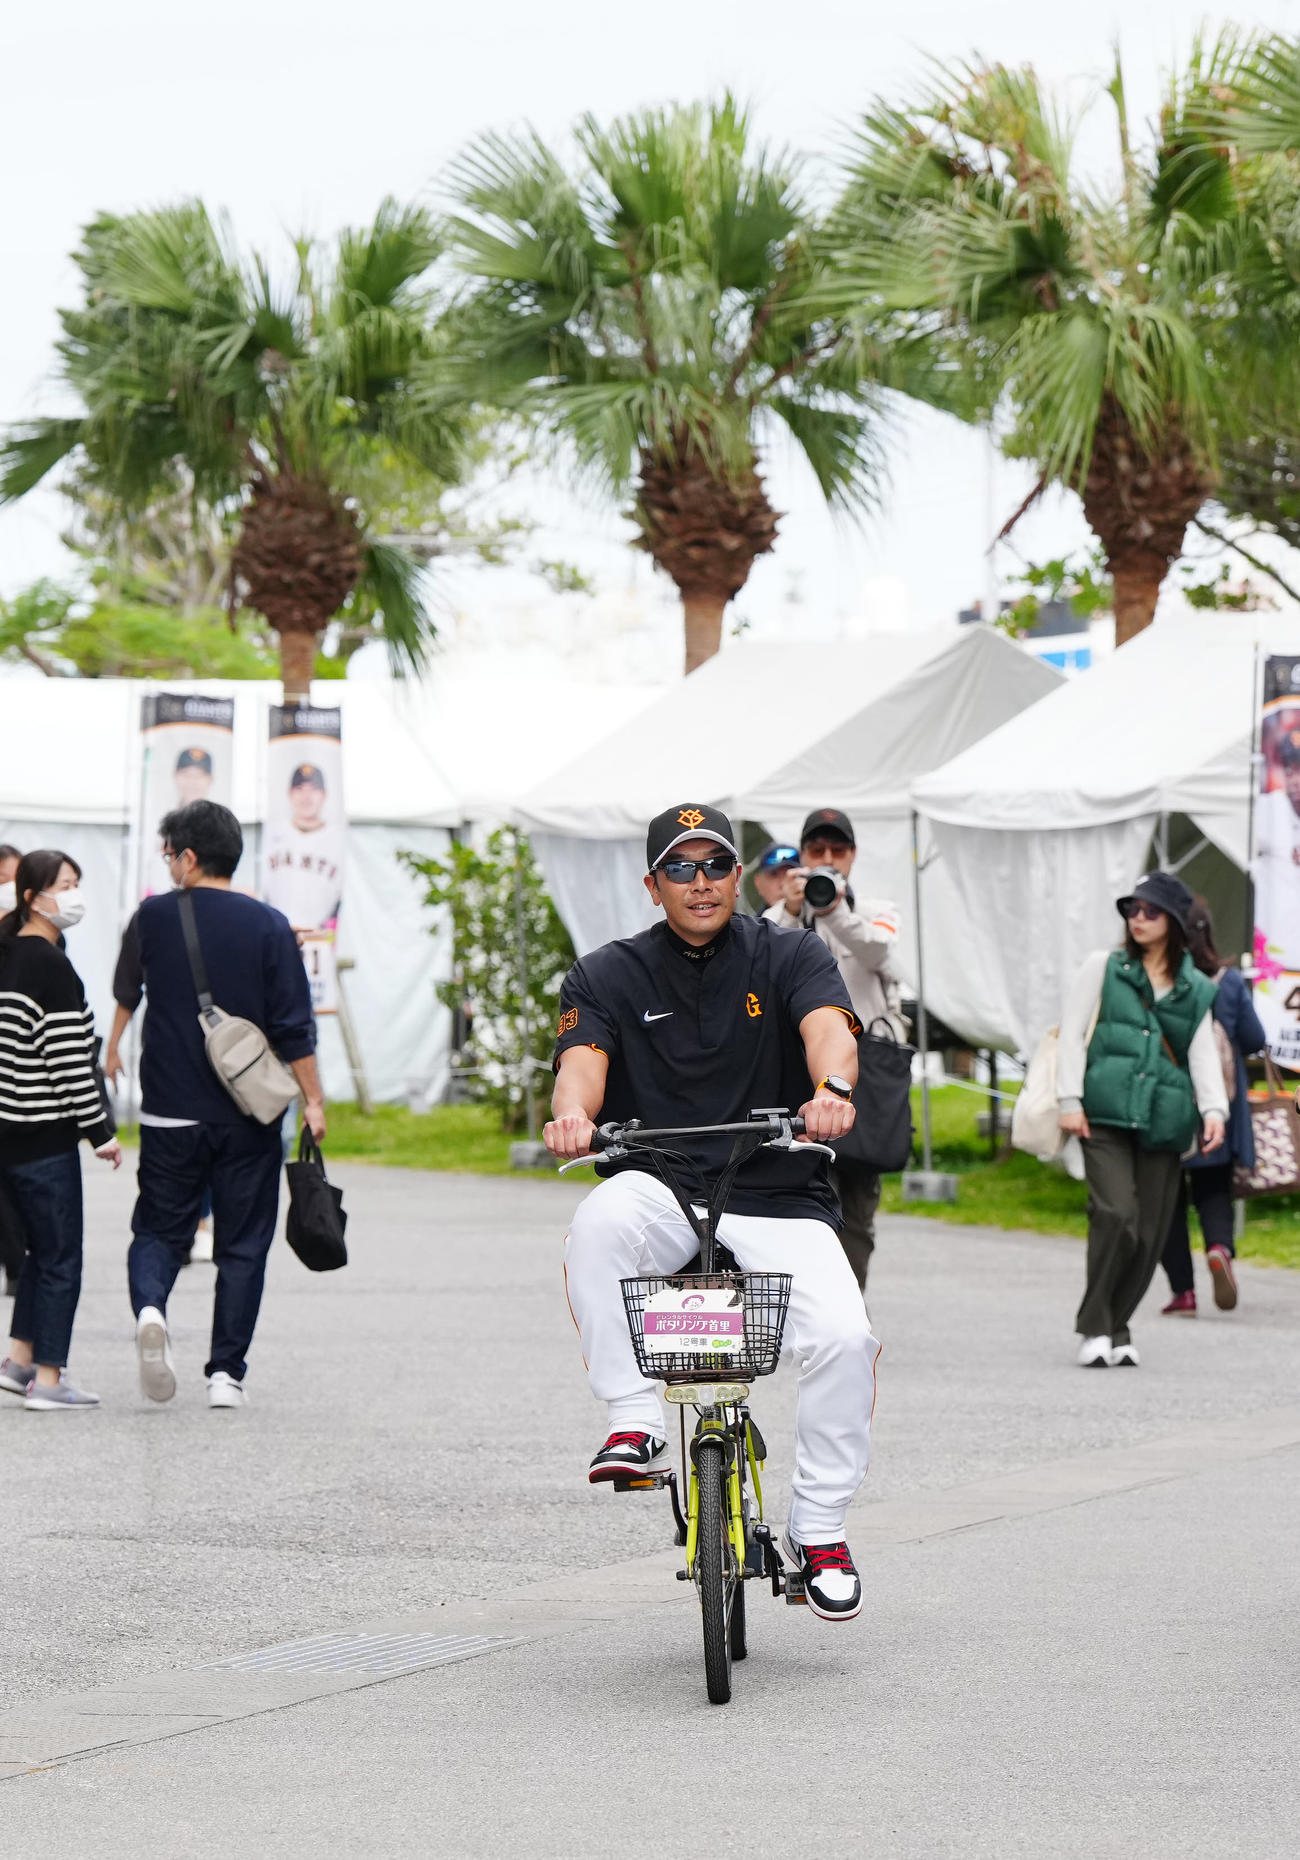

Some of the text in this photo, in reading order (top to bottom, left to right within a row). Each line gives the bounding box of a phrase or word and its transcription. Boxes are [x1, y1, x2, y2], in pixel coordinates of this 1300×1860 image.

[655, 1319, 731, 1332] ポタリング首里
[679, 1337, 709, 1347] 12号車
